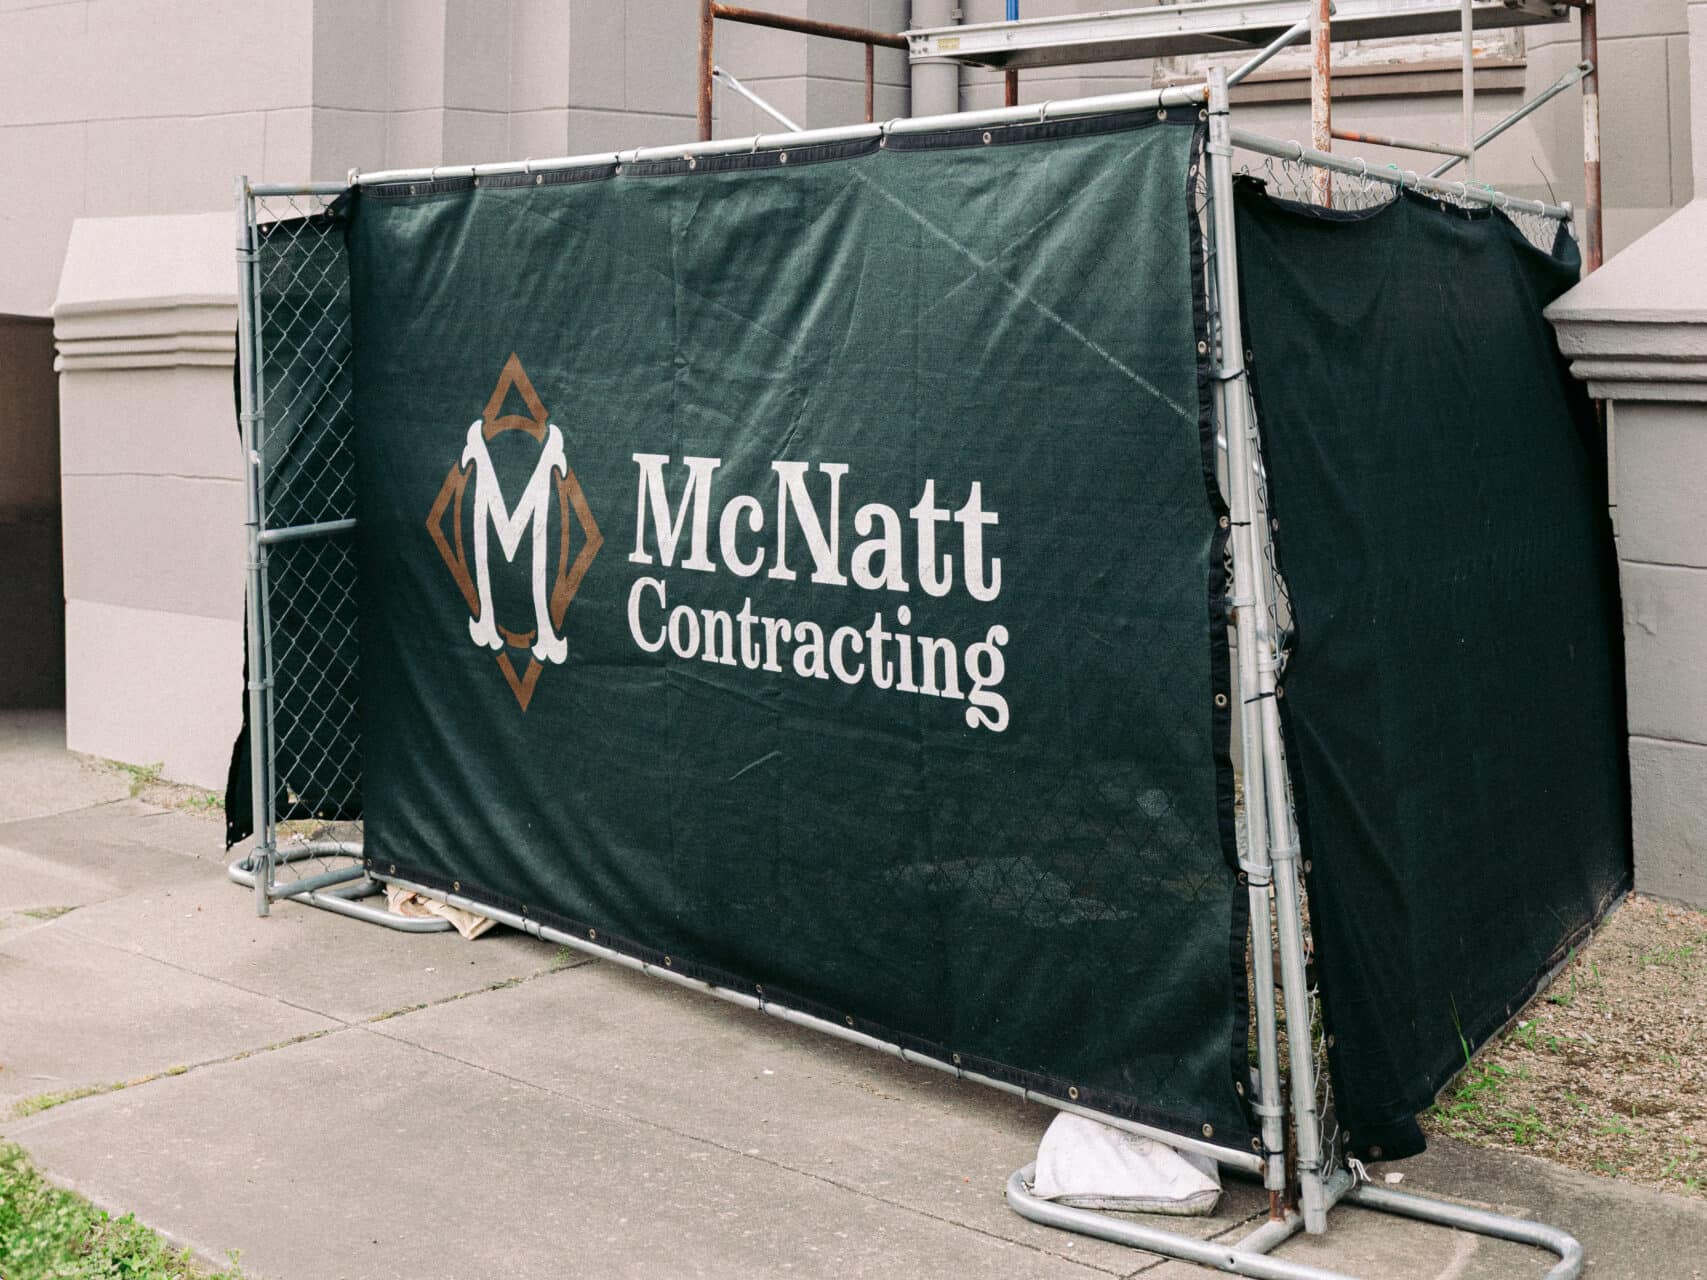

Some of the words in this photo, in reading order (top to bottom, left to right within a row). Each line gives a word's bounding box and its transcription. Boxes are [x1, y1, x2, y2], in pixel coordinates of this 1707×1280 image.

[461, 419, 568, 665] M
[628, 452, 1002, 602] McNatt
[627, 576, 1010, 732] Contracting
